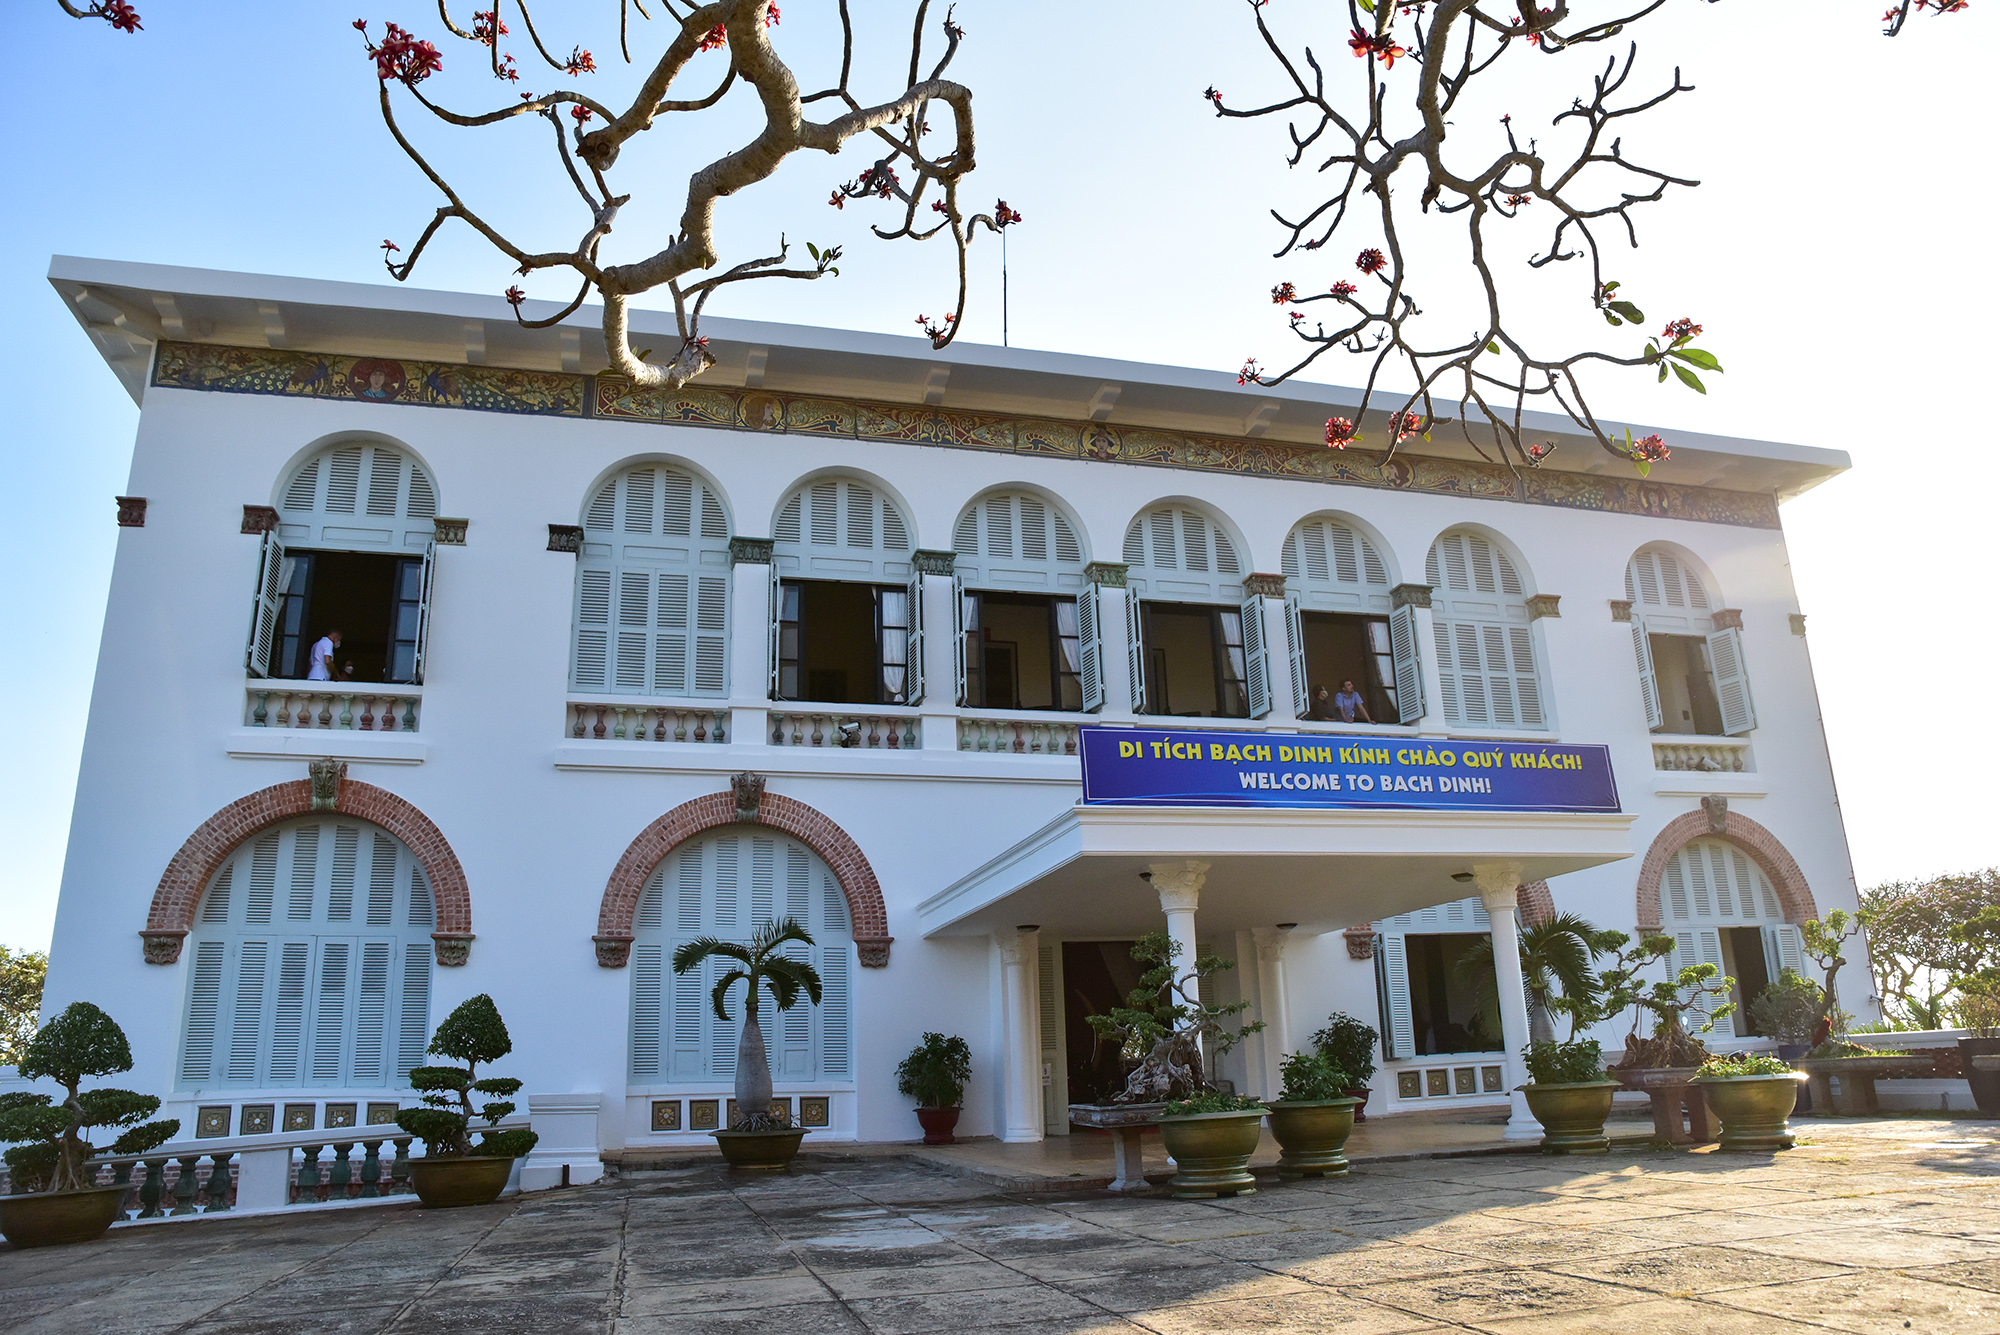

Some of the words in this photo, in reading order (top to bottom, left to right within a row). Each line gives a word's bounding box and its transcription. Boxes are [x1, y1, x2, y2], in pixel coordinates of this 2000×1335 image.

[1119, 741, 1142, 758] DI
[1150, 737, 1202, 760] TÍCH
[1210, 743, 1272, 765] BẠCH
[1279, 745, 1332, 763] DINH
[1339, 743, 1390, 764] KÍNH
[1397, 745, 1456, 766] CHÀO
[1463, 748, 1503, 768] QUÝ
[1510, 749, 1582, 770] KHÁCH!
[1239, 772, 1341, 790] WELCOME
[1346, 774, 1374, 791] TO
[1380, 775, 1433, 792] BACH
[1439, 776, 1492, 794] DINH!
